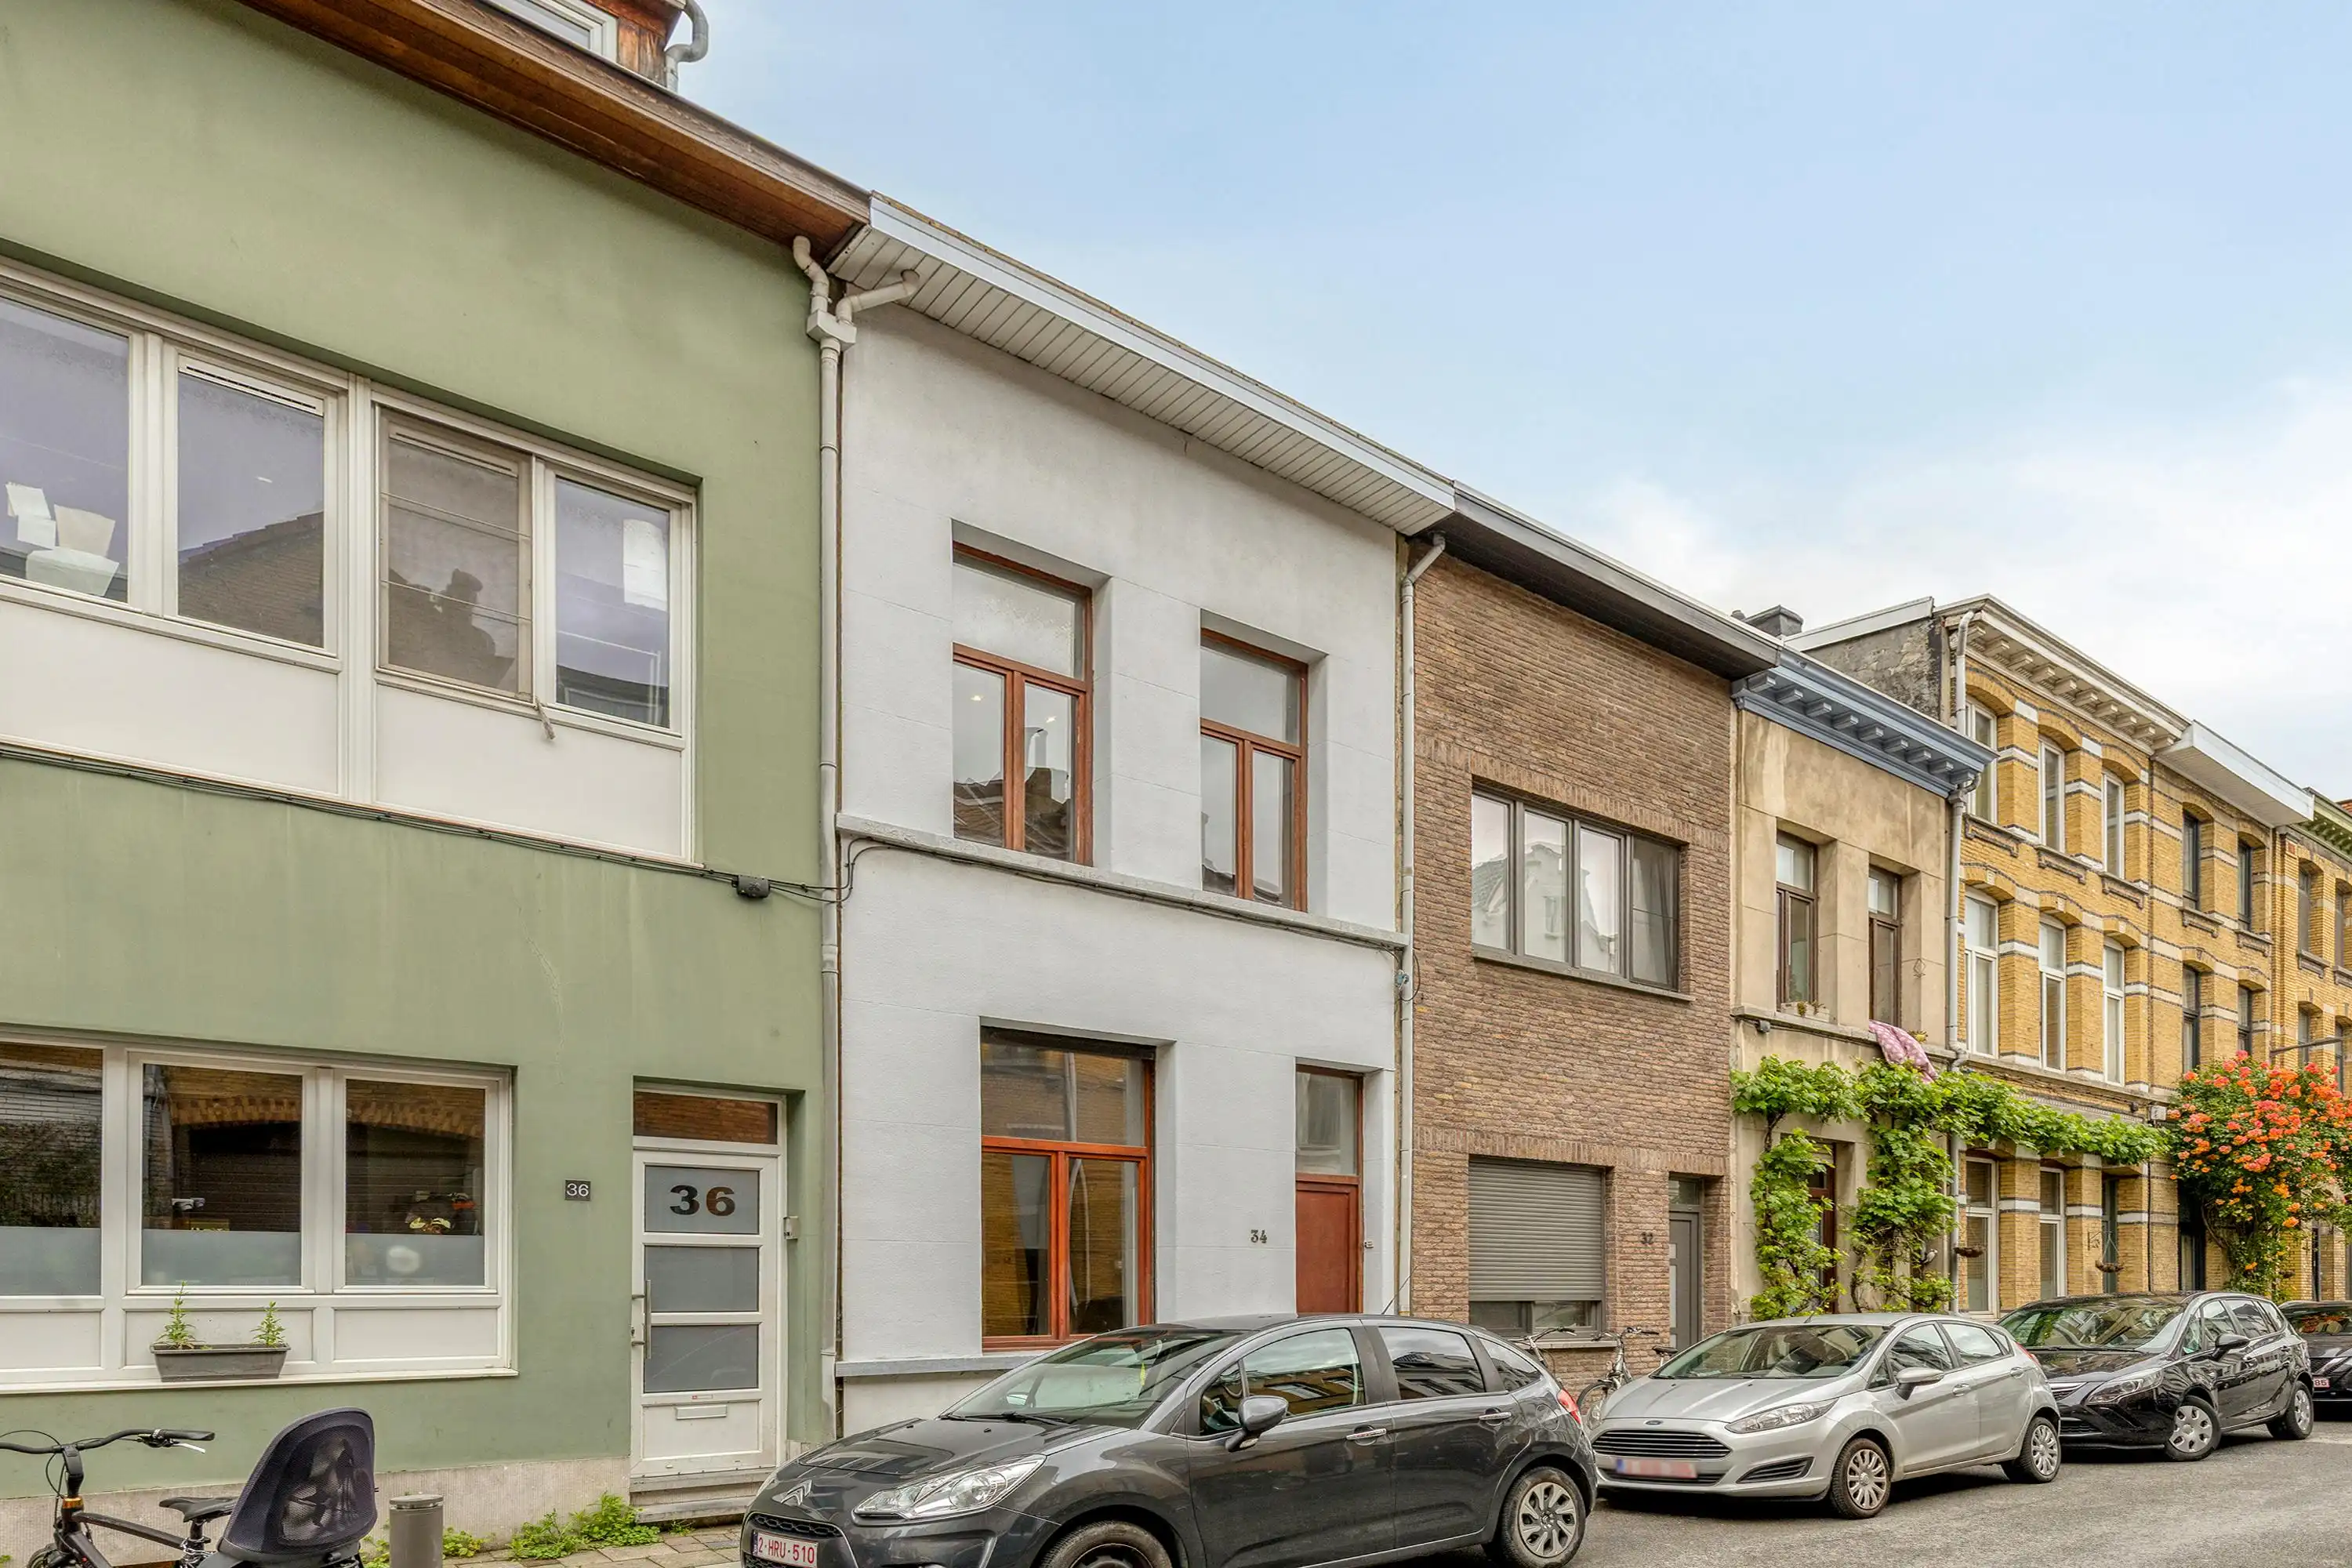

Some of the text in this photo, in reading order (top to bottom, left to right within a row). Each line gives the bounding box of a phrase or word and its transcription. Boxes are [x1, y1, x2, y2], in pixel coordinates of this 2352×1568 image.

[567, 1183, 589, 1196] 36
[670, 1185, 735, 1216] 36
[1250, 1229, 1268, 1243] 34
